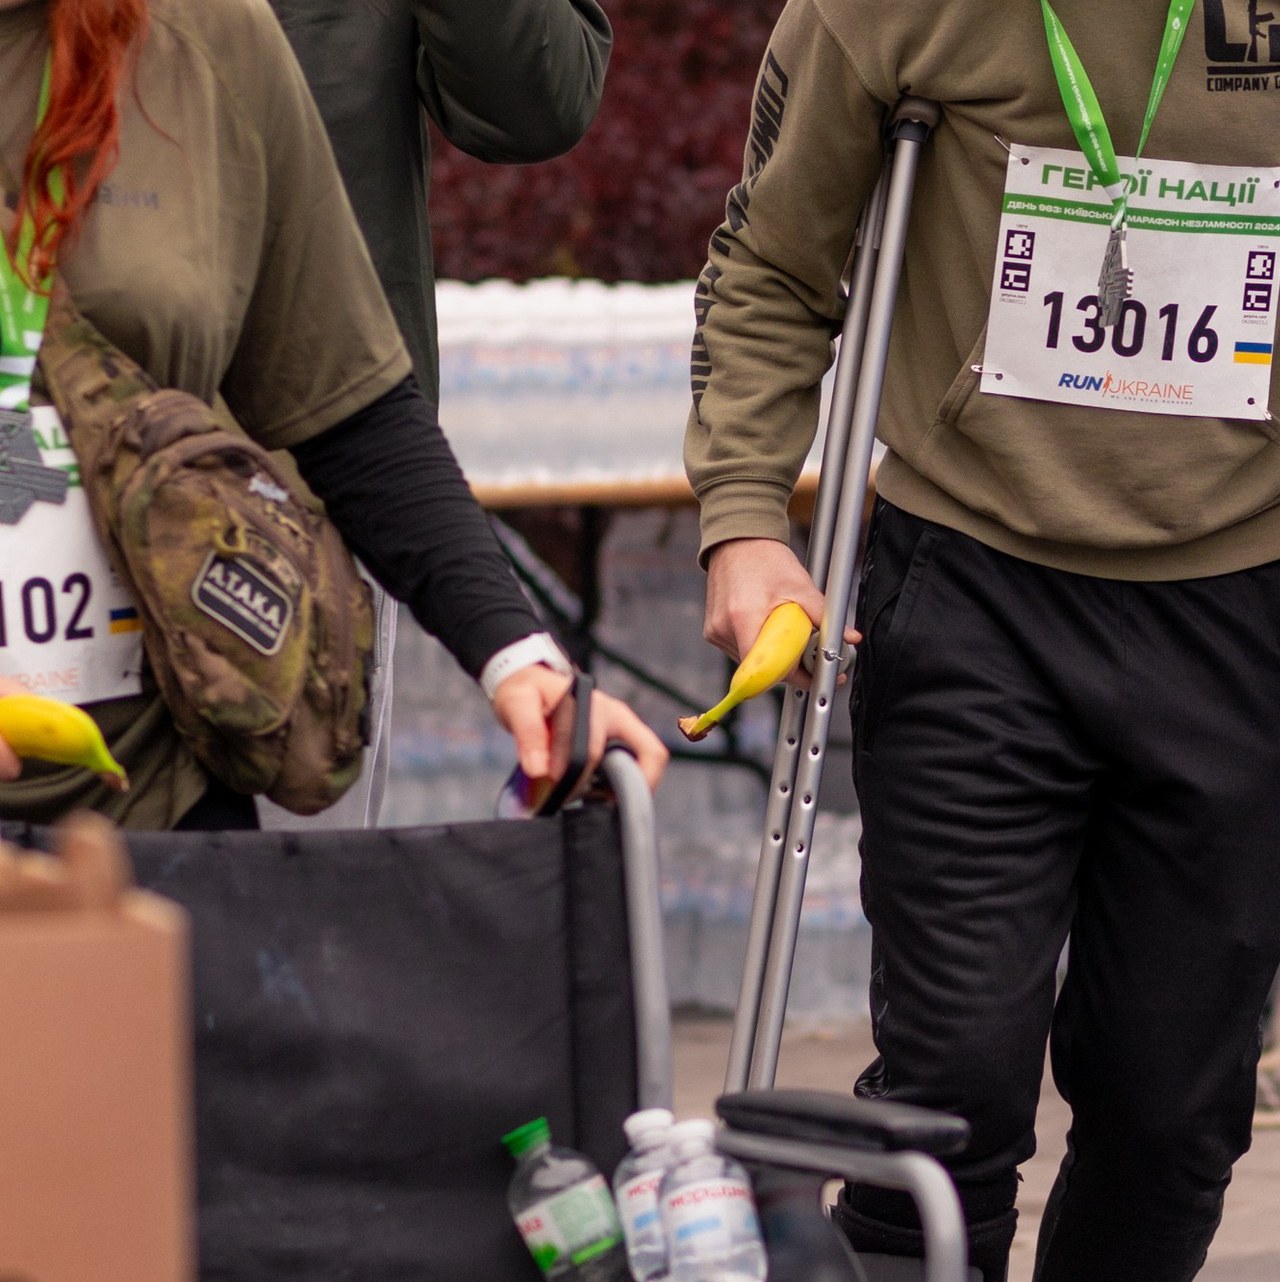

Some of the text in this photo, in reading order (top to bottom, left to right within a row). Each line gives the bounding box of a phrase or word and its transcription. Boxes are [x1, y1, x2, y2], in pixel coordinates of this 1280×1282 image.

[1206, 77, 1270, 92] COMPANY
[1158, 177, 1261, 207] НАЦІЇ
[1007, 200, 1037, 211] ДЕНЬ
[1127, 214, 1180, 227] МАРАФОН
[1181, 218, 1253, 230] НЕЗЛАМНОСТІ
[1254, 222, 1280, 231] 2024
[1043, 290, 1219, 364] 13016
[1058, 373, 1104, 392] RUN
